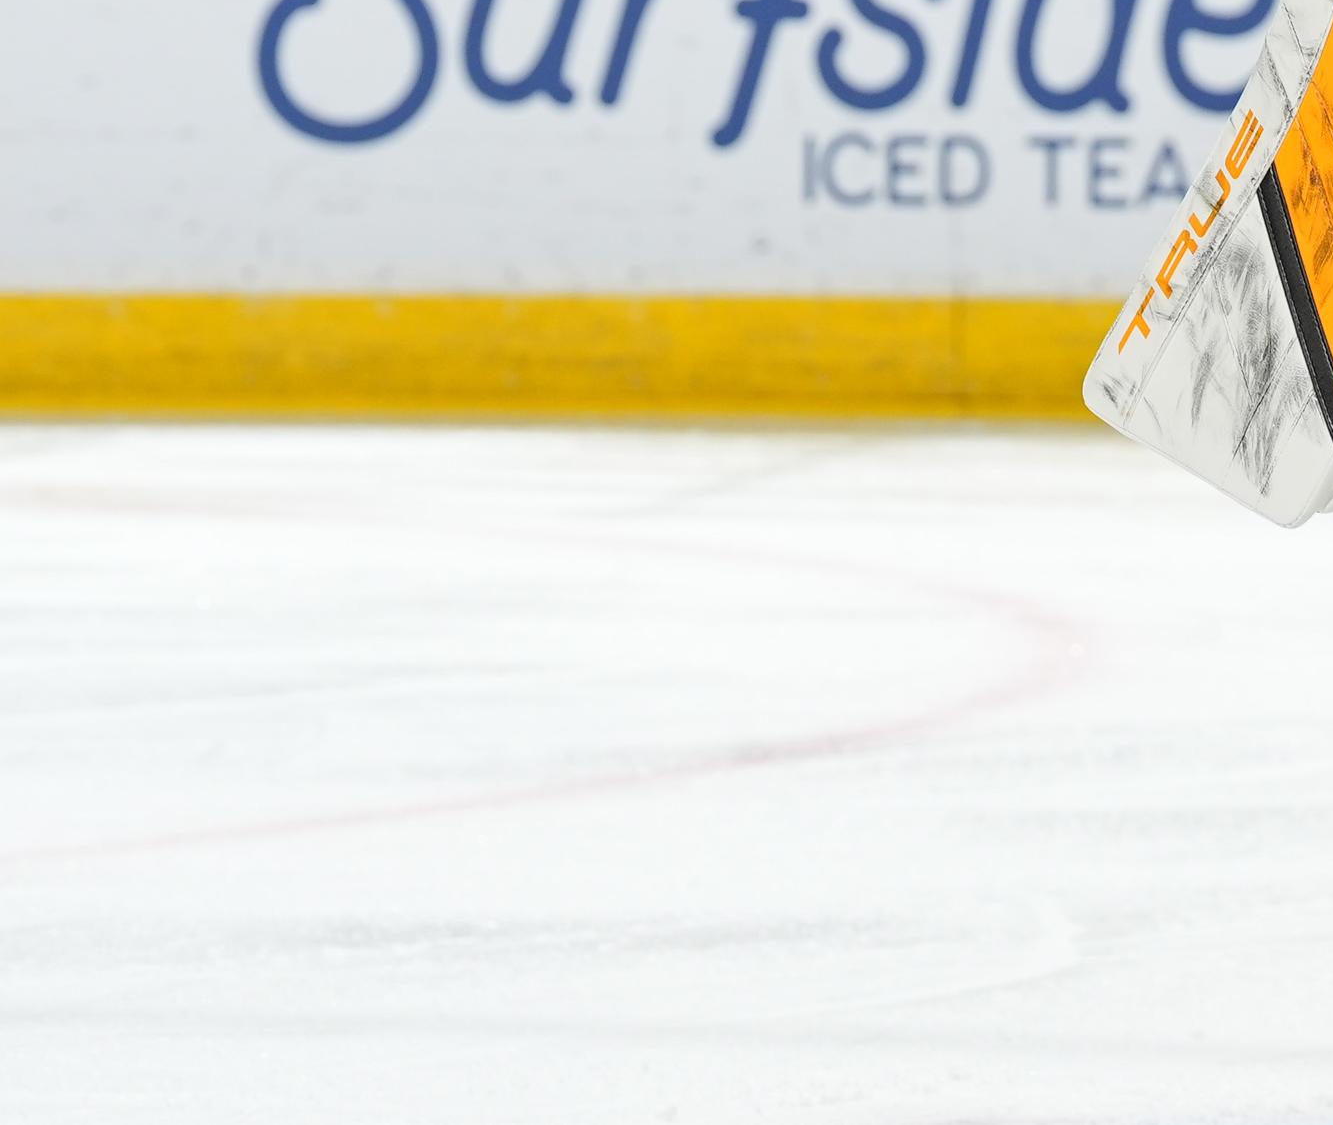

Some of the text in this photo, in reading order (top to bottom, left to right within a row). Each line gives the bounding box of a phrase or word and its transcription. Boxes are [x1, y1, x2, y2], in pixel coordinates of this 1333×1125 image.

[803, 133, 1194, 208] ICED TEA
[1119, 110, 1264, 354] TRUE
